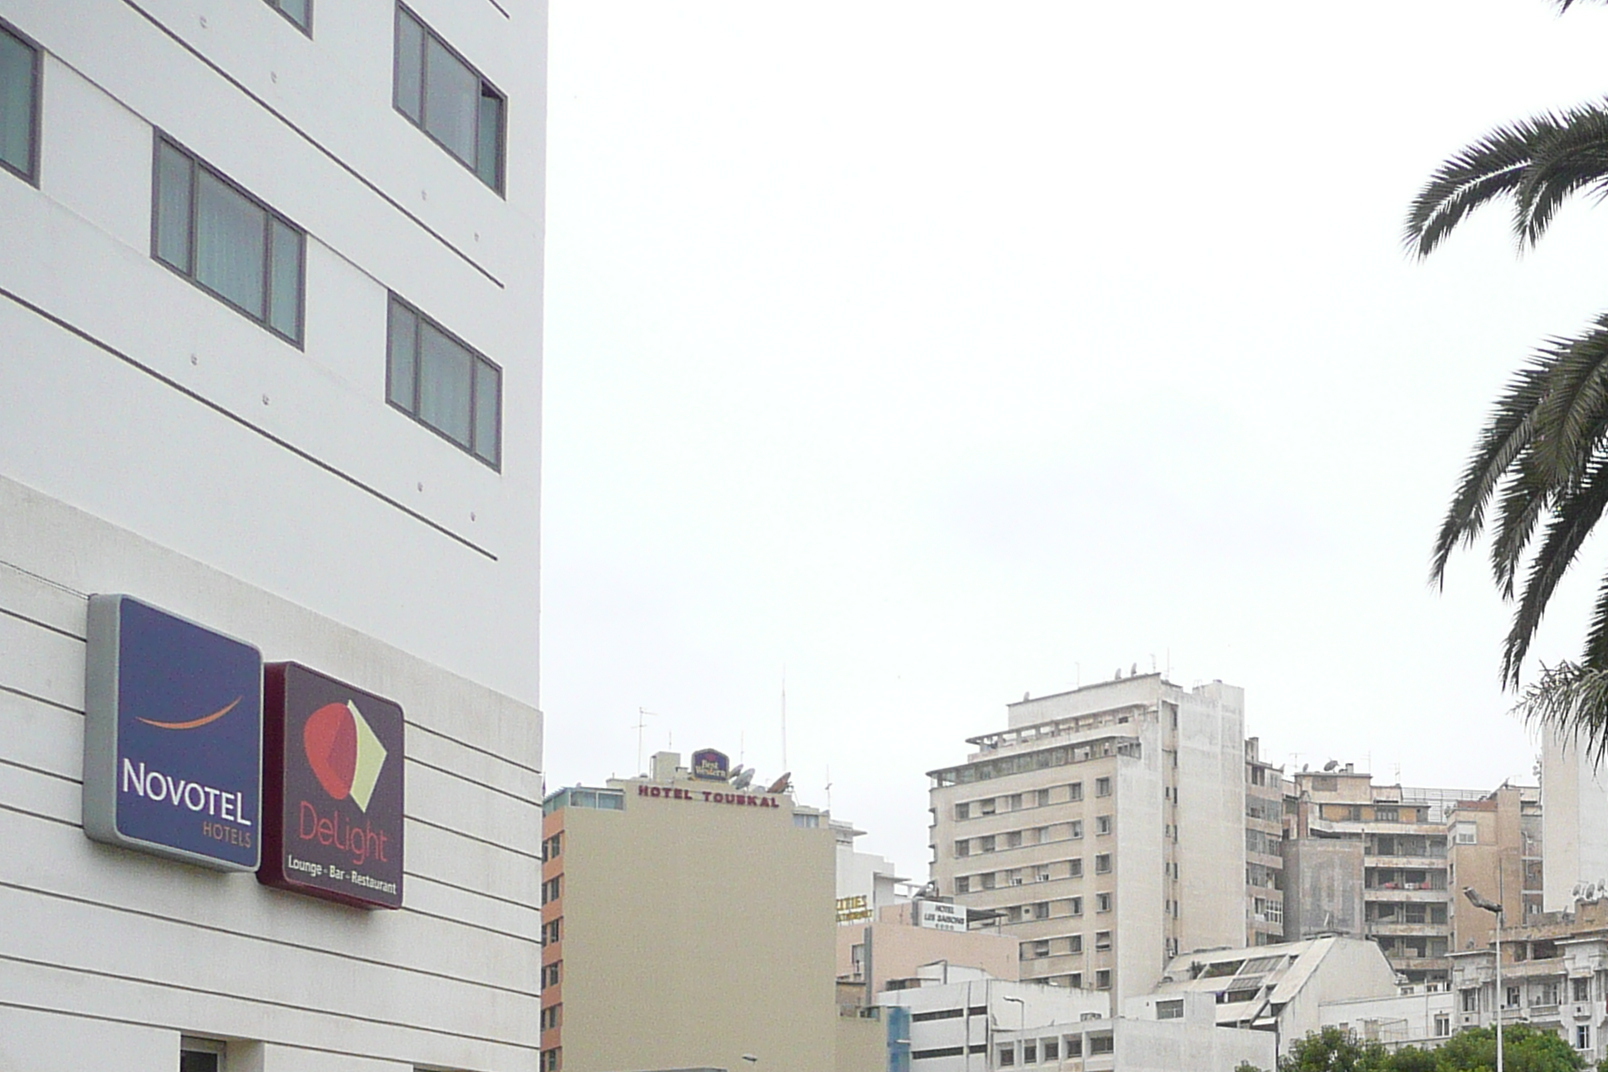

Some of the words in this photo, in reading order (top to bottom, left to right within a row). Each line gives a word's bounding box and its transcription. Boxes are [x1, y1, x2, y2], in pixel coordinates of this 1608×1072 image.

[122, 757, 252, 826] NOVOTEL
[638, 785, 693, 800] HOTEL
[702, 791, 779, 808] TOUBKAL
[203, 821, 251, 849] HOTELS
[288, 854, 322, 877] Lounge
[329, 865, 345, 880] Bar
[351, 870, 397, 895] Restaurant
